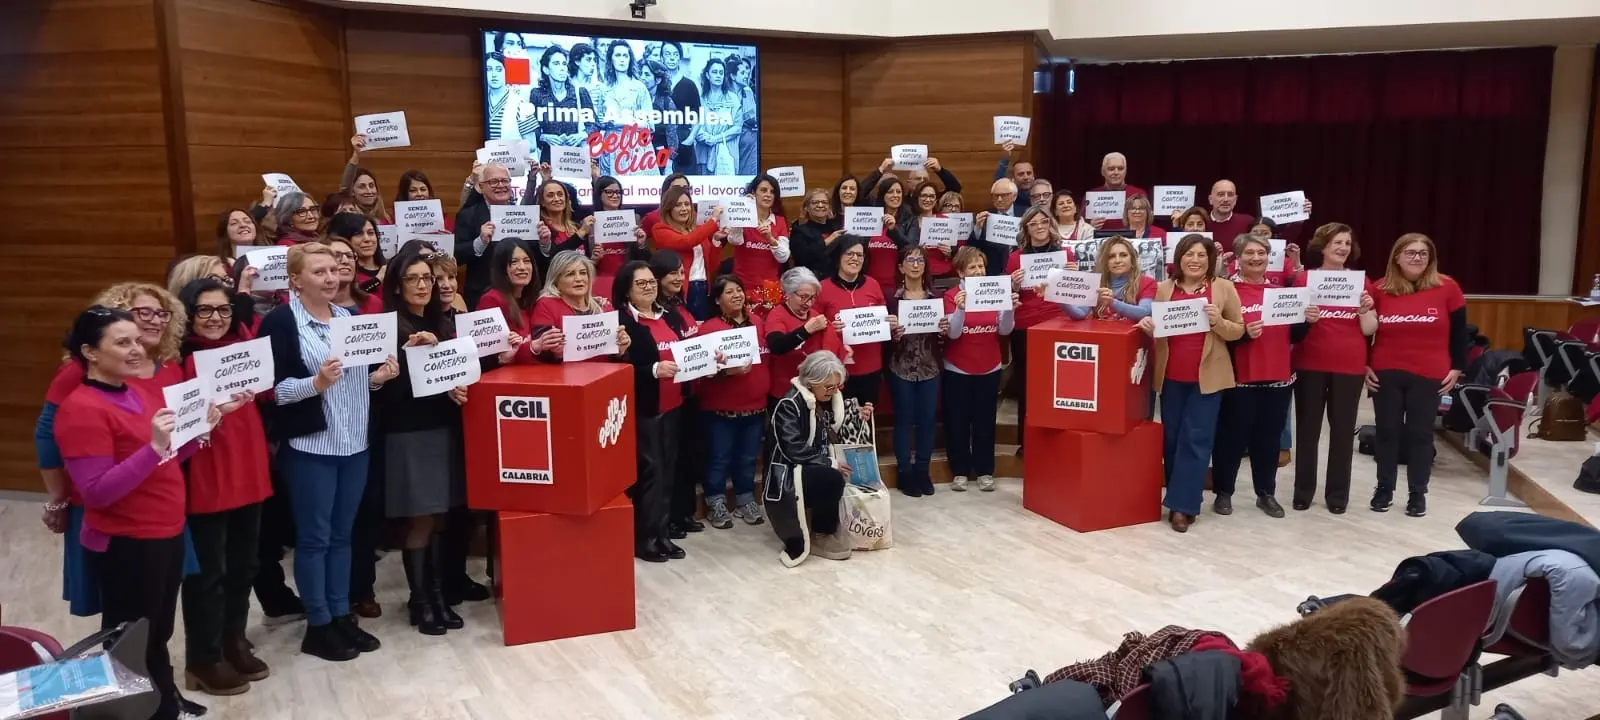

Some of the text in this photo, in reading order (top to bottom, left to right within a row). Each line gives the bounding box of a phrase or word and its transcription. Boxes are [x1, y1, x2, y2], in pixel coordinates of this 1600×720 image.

[521, 103, 734, 126] Prima Assemblea
[587, 123, 655, 159] Belle
[614, 147, 674, 176] Ciao
[709, 184, 746, 196] lavoro
[270, 274, 288, 282] stup
[1061, 292, 1086, 300] stupro
[352, 323, 378, 331] SENZA
[474, 317, 495, 326] SENZA
[582, 321, 604, 329] SENZA
[1171, 322, 1197, 330] stupro
[469, 325, 502, 338] CONSENSO
[576, 328, 611, 340] CONSENSO
[345, 332, 386, 344] CONSENSO
[352, 347, 382, 355] stupro
[583, 342, 607, 351] stupro
[220, 350, 250, 364] SENZA
[429, 348, 457, 359] SENZA
[1056, 345, 1095, 361] CGIL
[215, 360, 261, 379] CONSENSO
[424, 355, 467, 372] CONSENSO
[224, 376, 260, 391] stupro
[435, 371, 467, 384] stupro
[499, 400, 547, 418] CGIL
[1056, 400, 1094, 409] CALABRIA
[502, 471, 549, 481] CALABRIA
